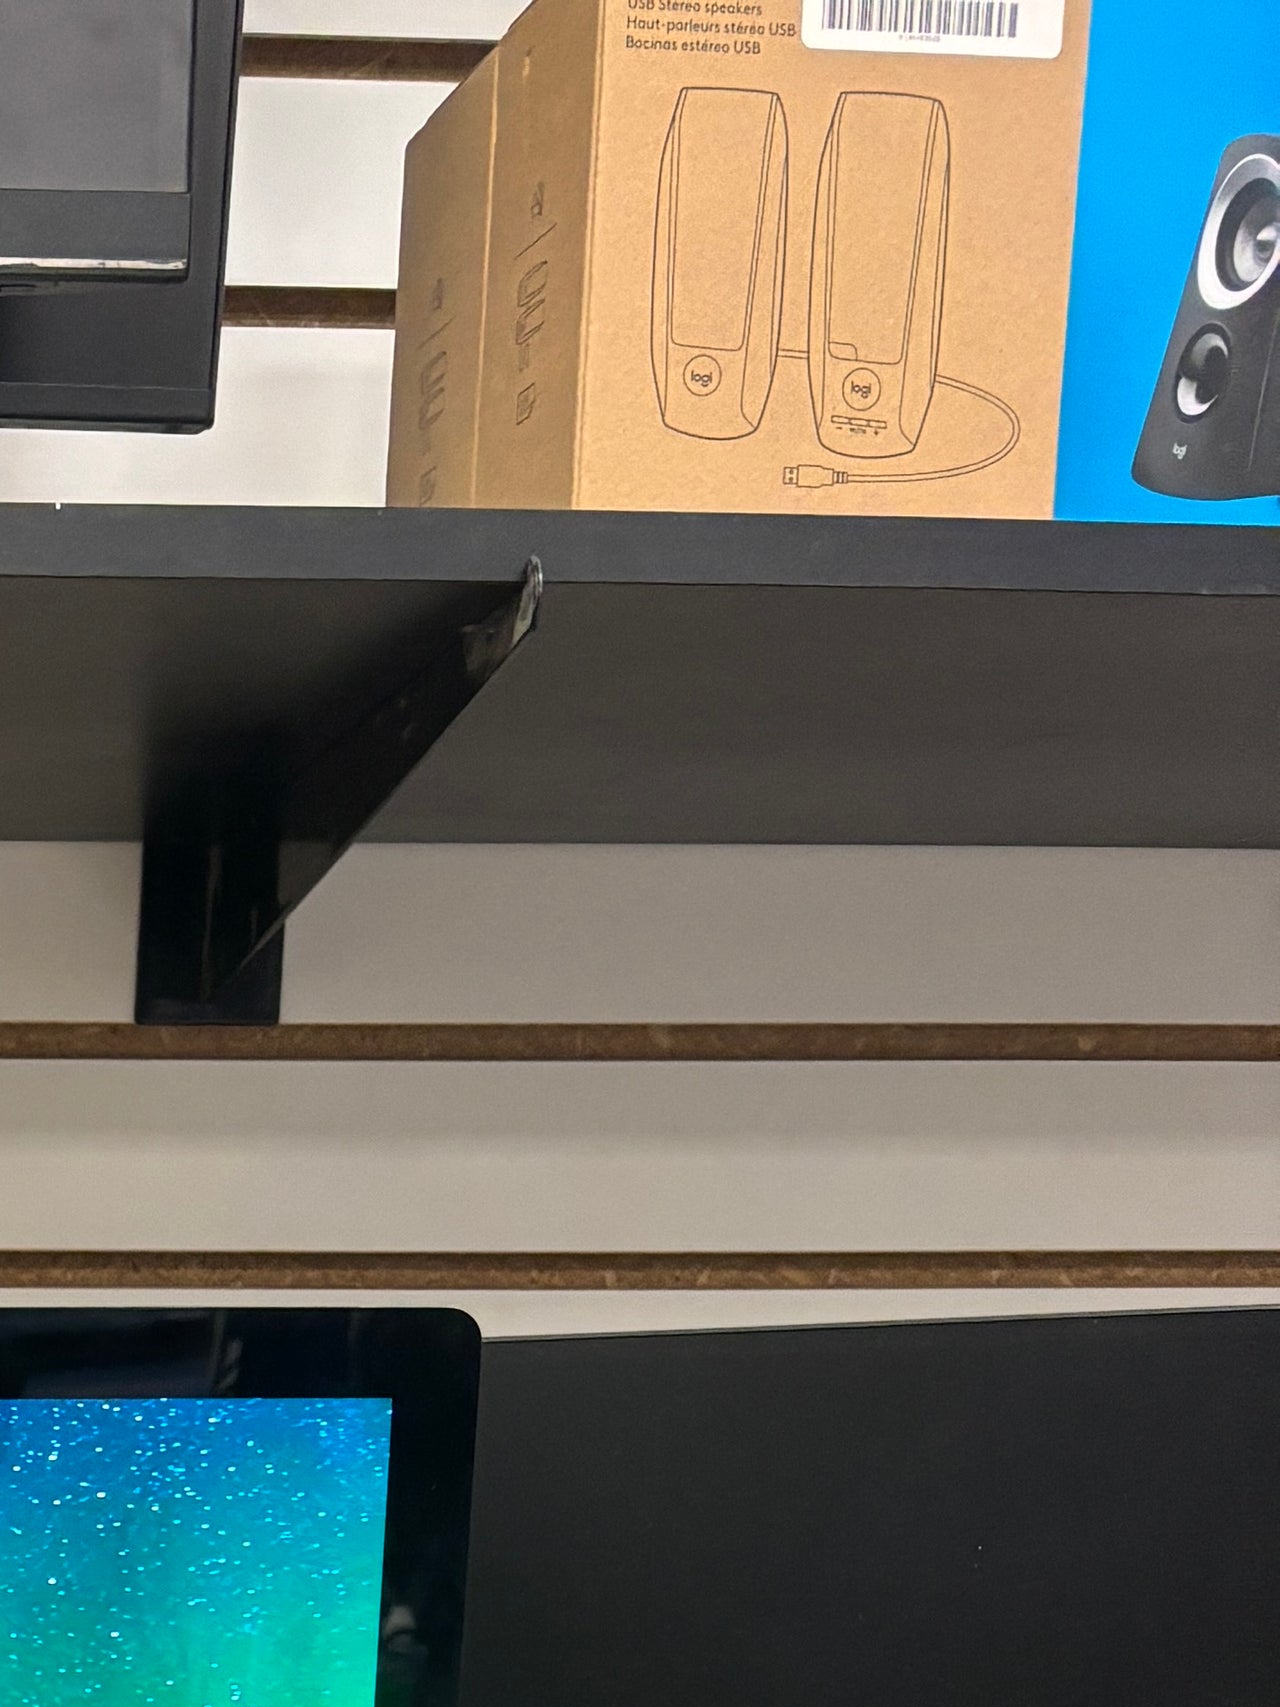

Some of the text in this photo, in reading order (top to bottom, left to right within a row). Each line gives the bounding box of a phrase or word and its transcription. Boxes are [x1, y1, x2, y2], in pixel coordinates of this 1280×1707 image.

[704, 0, 762, 16] speakers
[626, 16, 720, 34] Haut-parleurs
[768, 24, 796, 37] USB
[625, 35, 678, 51] Bocinas
[733, 41, 761, 55] USB
[690, 370, 713, 387] logi
[851, 381, 872, 398] logi
